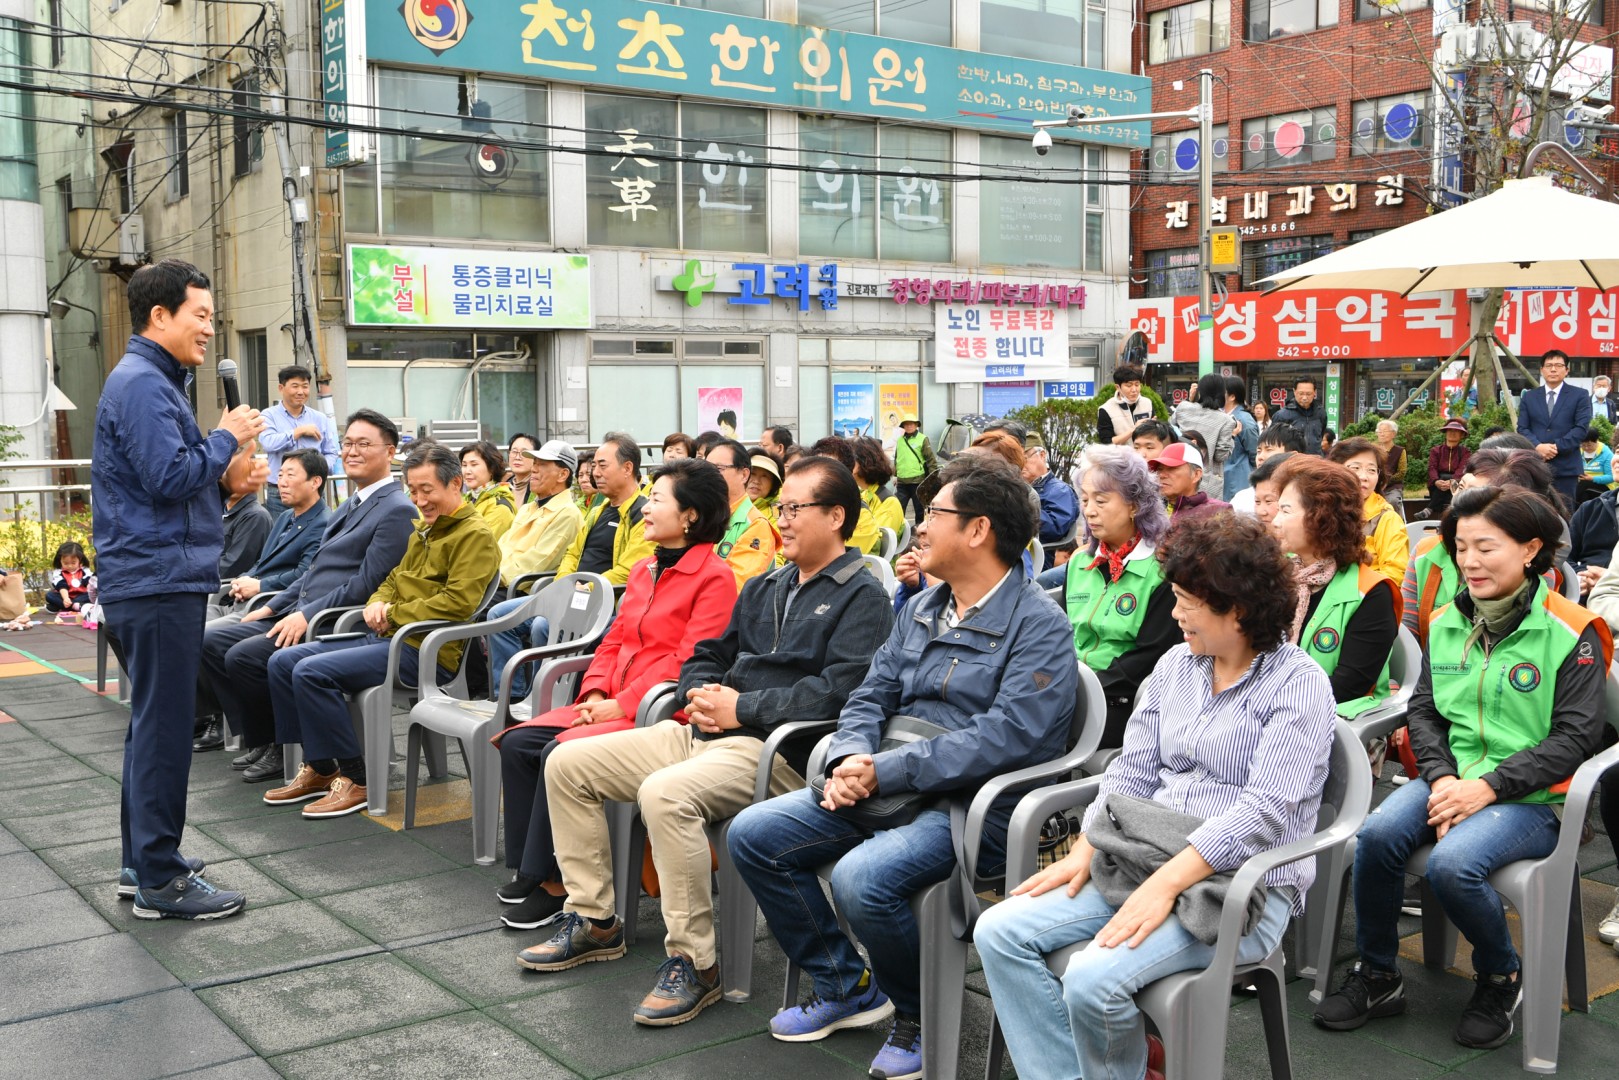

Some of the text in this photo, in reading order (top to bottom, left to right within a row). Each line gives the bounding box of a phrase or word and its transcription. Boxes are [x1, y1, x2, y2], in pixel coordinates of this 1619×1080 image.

[392, 263, 414, 313] 부설
[451, 264, 553, 290] 통증클리닉
[846, 284, 878, 297] 진료과목
[452, 293, 554, 317] 물리치료실
[948, 308, 1055, 331] 노인 무료독감
[953, 336, 1045, 359] 접종 합니다
[1277, 345, 1351, 358] 542-9000
[991, 366, 1019, 376] 고려의원
[1050, 383, 1087, 396] 고려의원
